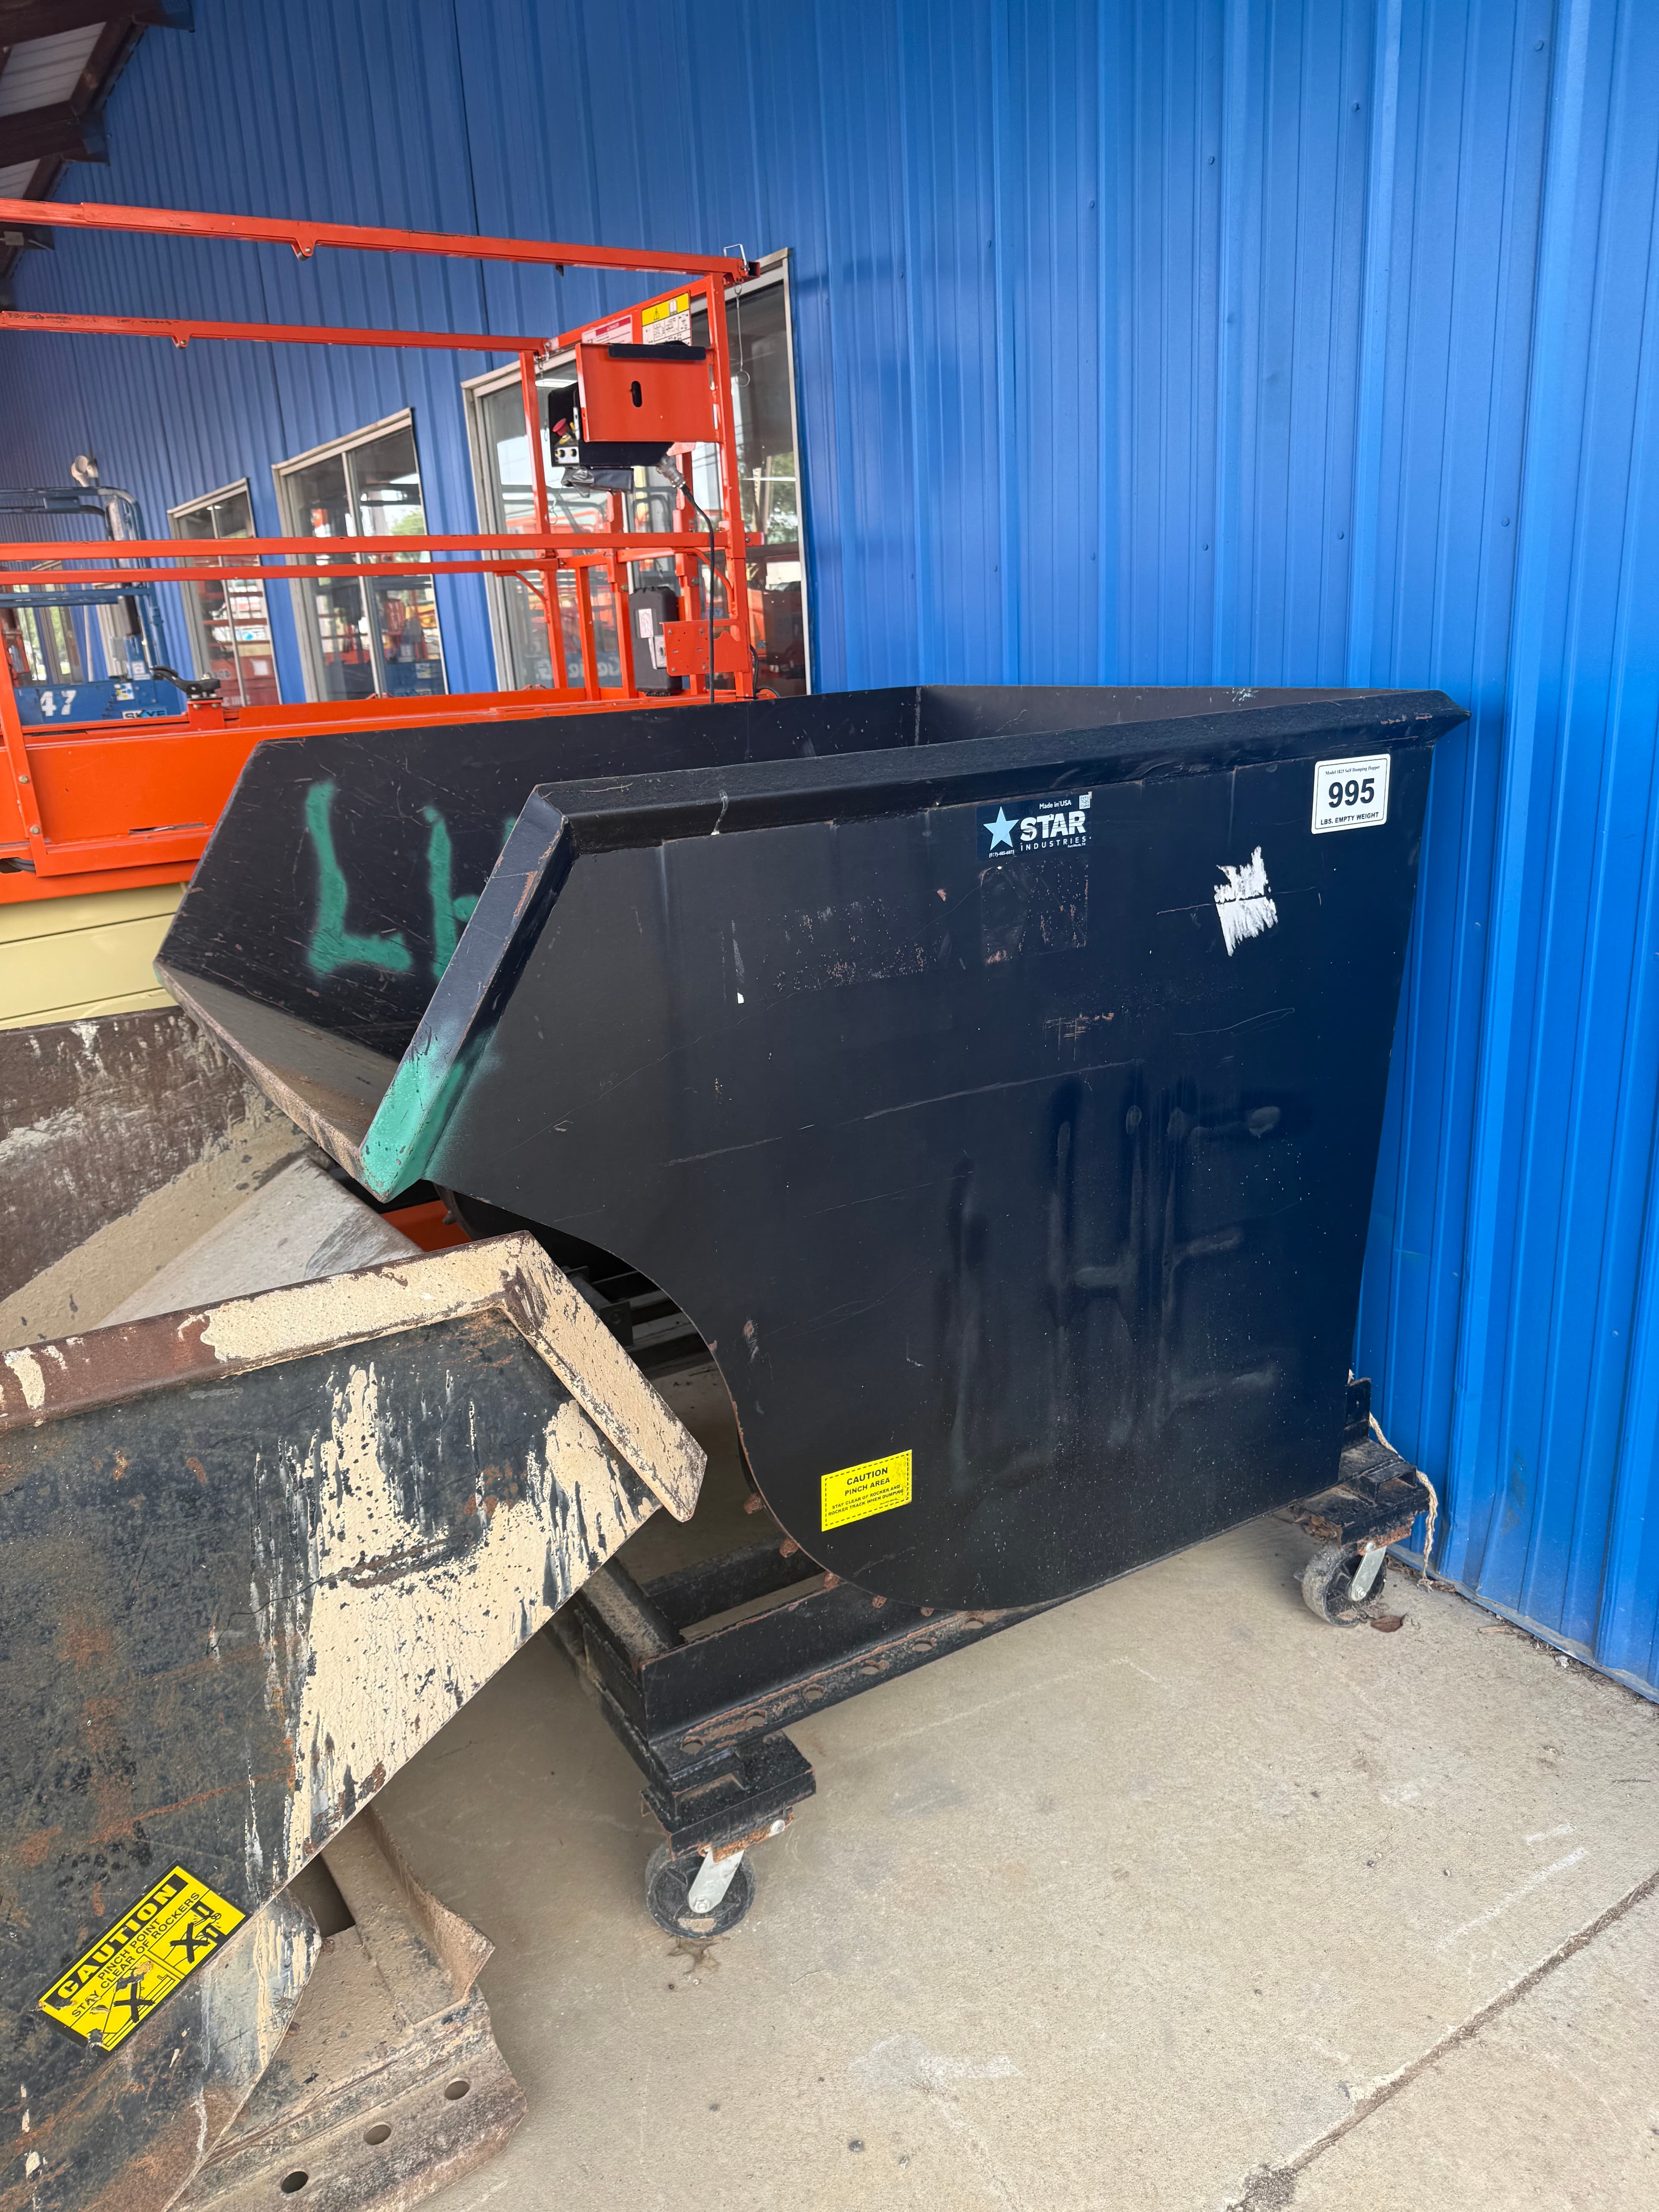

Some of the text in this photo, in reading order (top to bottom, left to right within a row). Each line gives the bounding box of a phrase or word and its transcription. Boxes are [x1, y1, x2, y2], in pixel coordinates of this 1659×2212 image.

[40, 690, 76, 716] 47
[1328, 778, 1374, 808] 995
[1020, 811, 1086, 841] STAR
[1356, 812, 1379, 820] WEIGHT
[1020, 836, 1086, 851] INDUSTRIES
[845, 1478, 890, 1496] PINCH AREA
[847, 1467, 888, 1485] CAUTION
[828, 1506, 848, 1516] ROCKER
[850, 1501, 866, 1510] TRACK
[882, 1489, 904, 1499] DUMPING
[870, 1487, 890, 1497] ROCKER
[57, 1884, 178, 1999] CAUTION
[98, 1918, 161, 1980] PINCH POINT
[71, 1892, 200, 2018] STAY CLEAR OF ROCKERS
